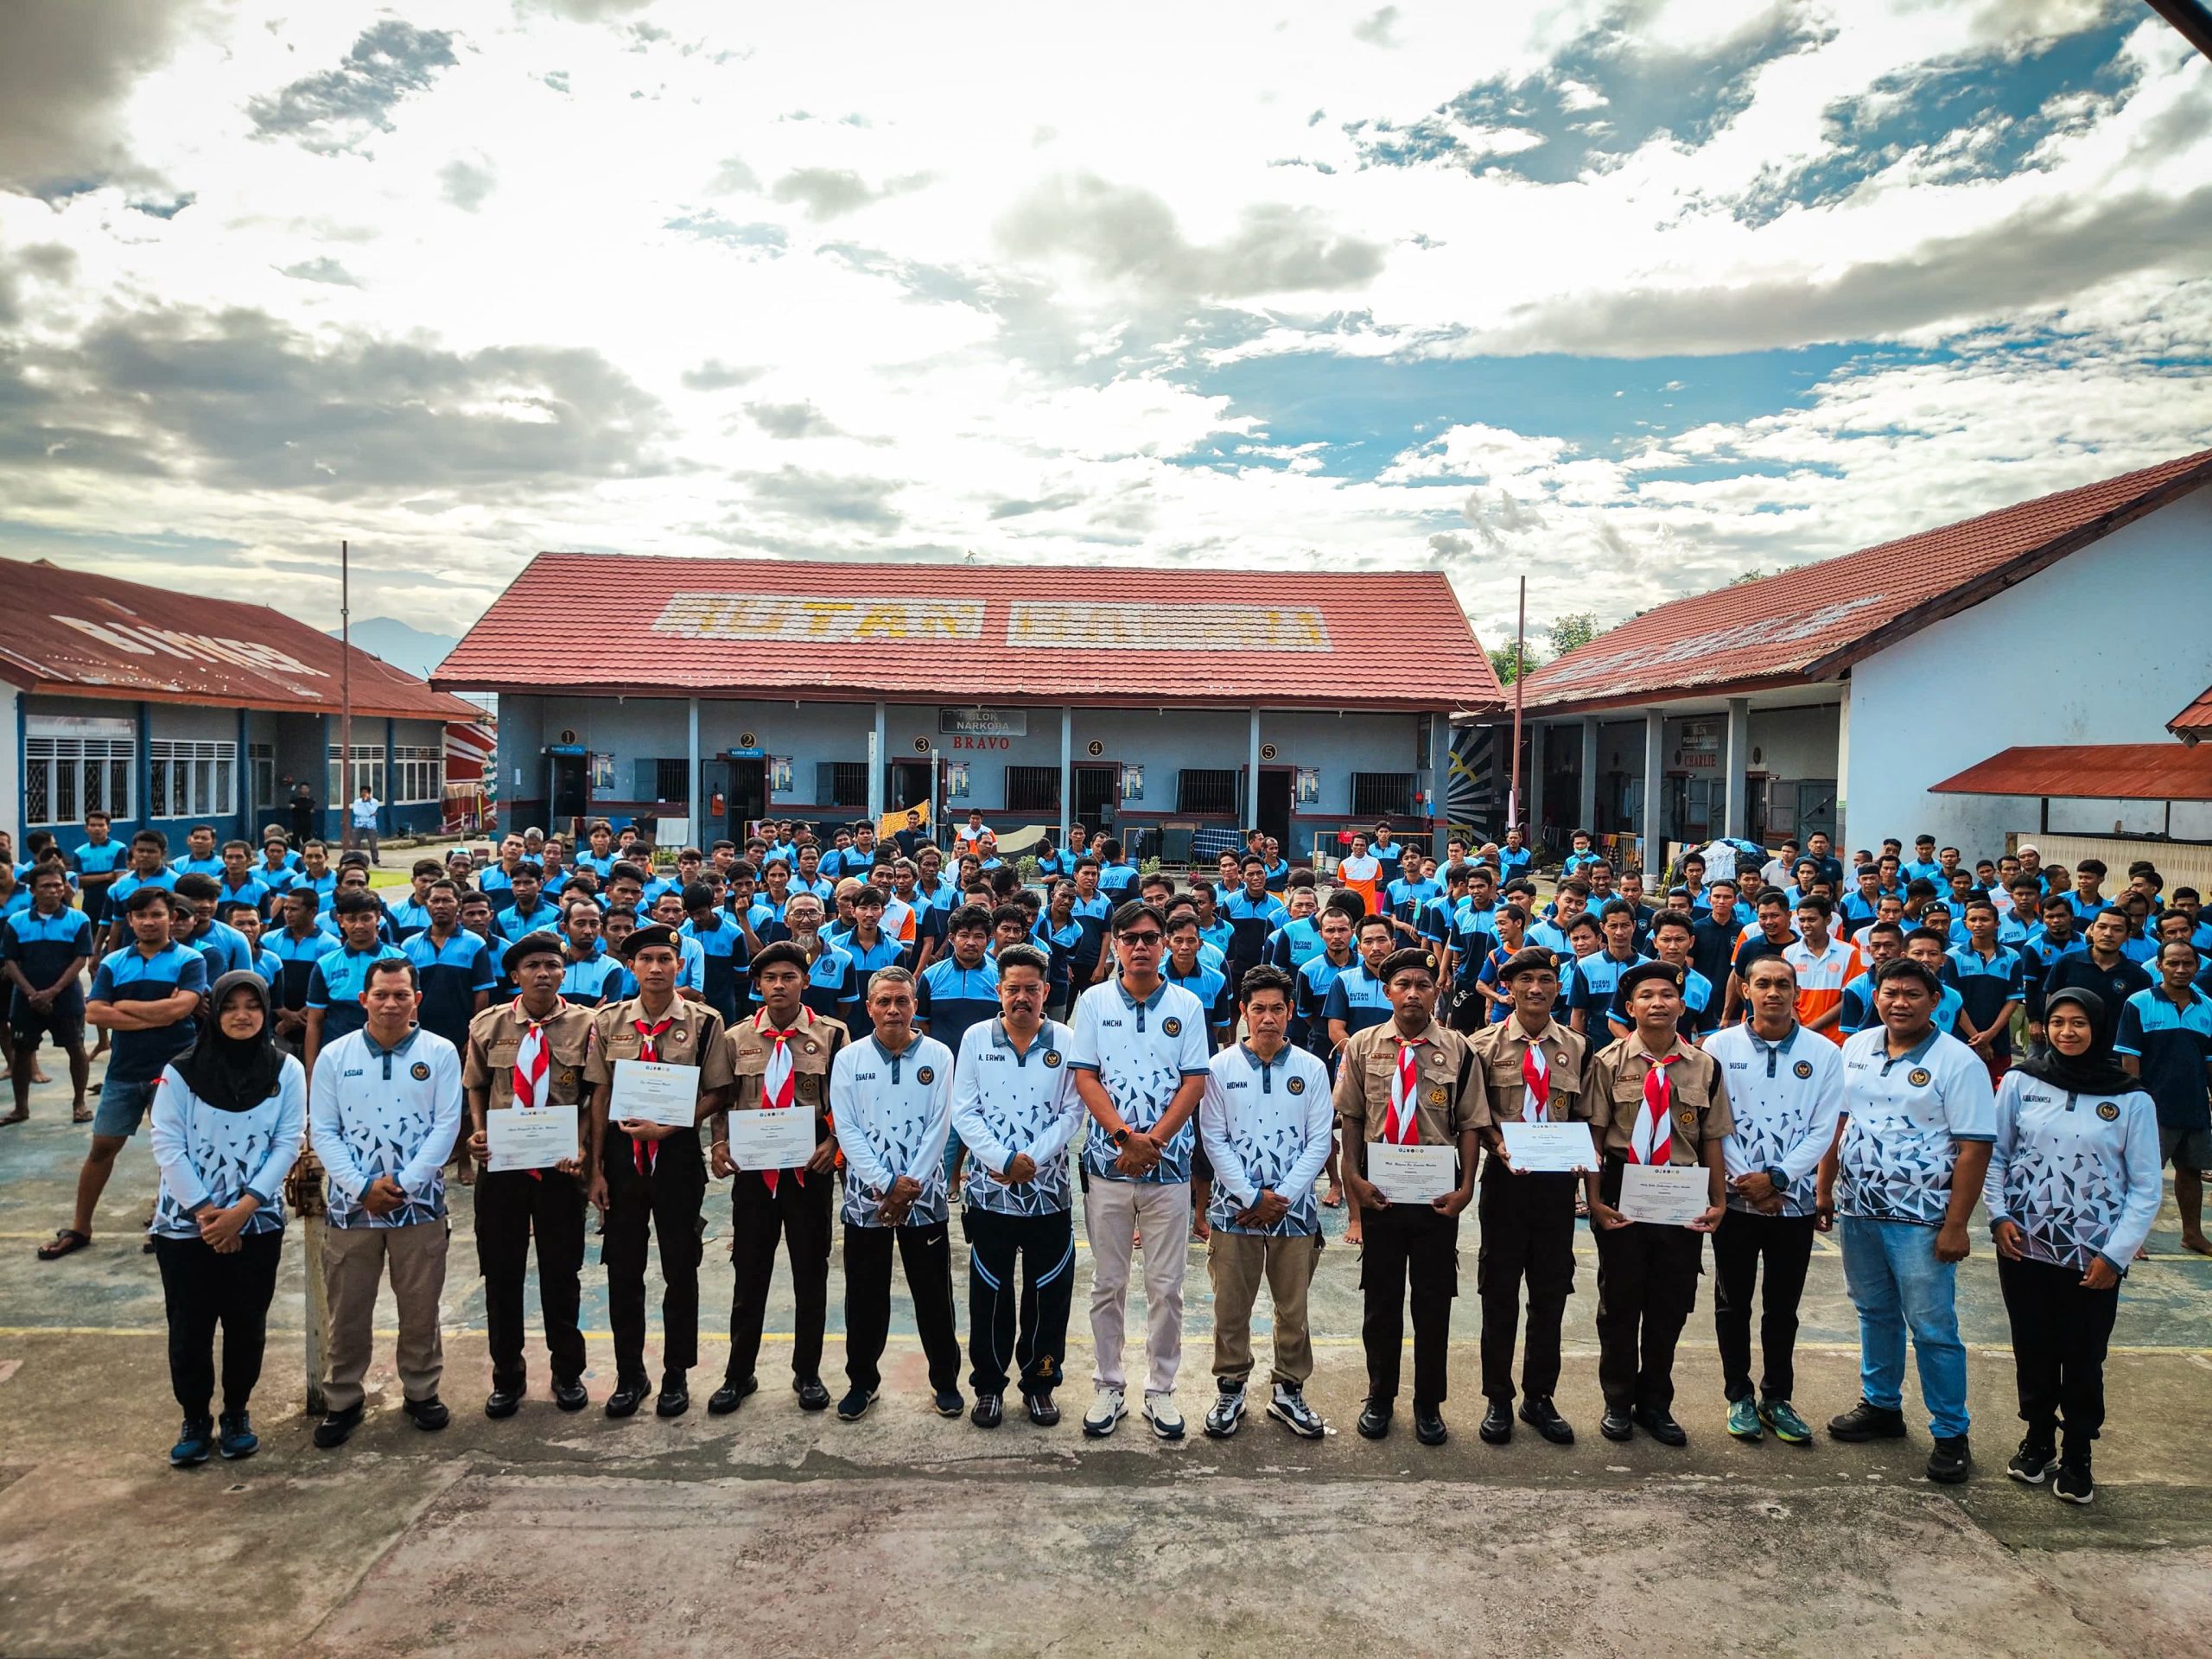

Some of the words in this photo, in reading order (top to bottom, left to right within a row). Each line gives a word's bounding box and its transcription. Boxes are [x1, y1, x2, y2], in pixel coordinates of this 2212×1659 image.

[957, 721, 1010, 731] NARKOBA
[743, 734, 753, 747] 2
[916, 738, 926, 751] 3
[953, 736, 1010, 750] BRAVO
[1090, 742, 1100, 754] 4
[1264, 747, 1274, 758] 5
[986, 1053, 1006, 1062] ERWIN
[855, 1072, 876, 1081] SYAFAR
[1226, 1081, 1248, 1090] RIDWAN
